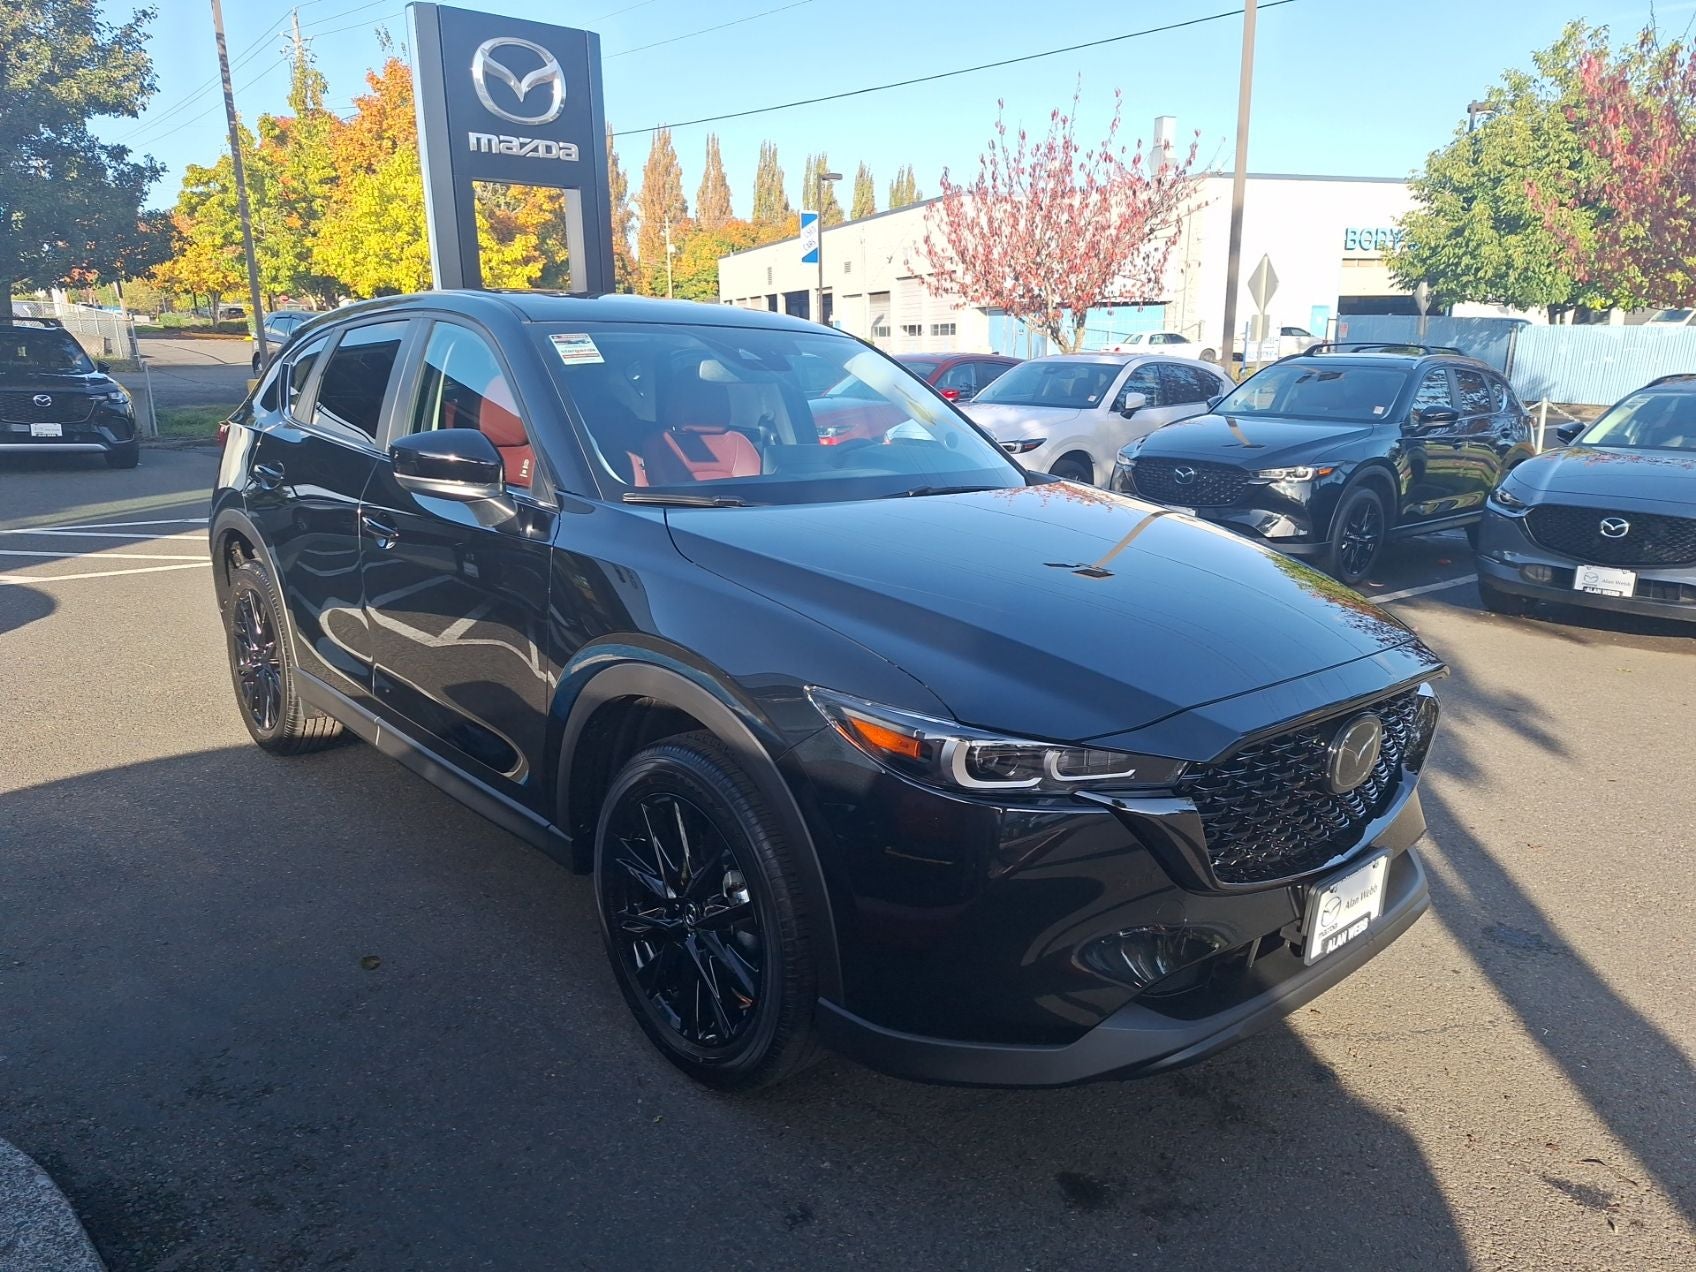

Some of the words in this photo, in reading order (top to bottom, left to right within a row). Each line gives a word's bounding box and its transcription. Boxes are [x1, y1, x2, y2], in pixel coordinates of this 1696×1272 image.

[468, 132, 580, 161] mazda
[1344, 227, 1404, 251] BODY
[1346, 896, 1360, 909] Alan
[1326, 929, 1348, 954] ALAN
